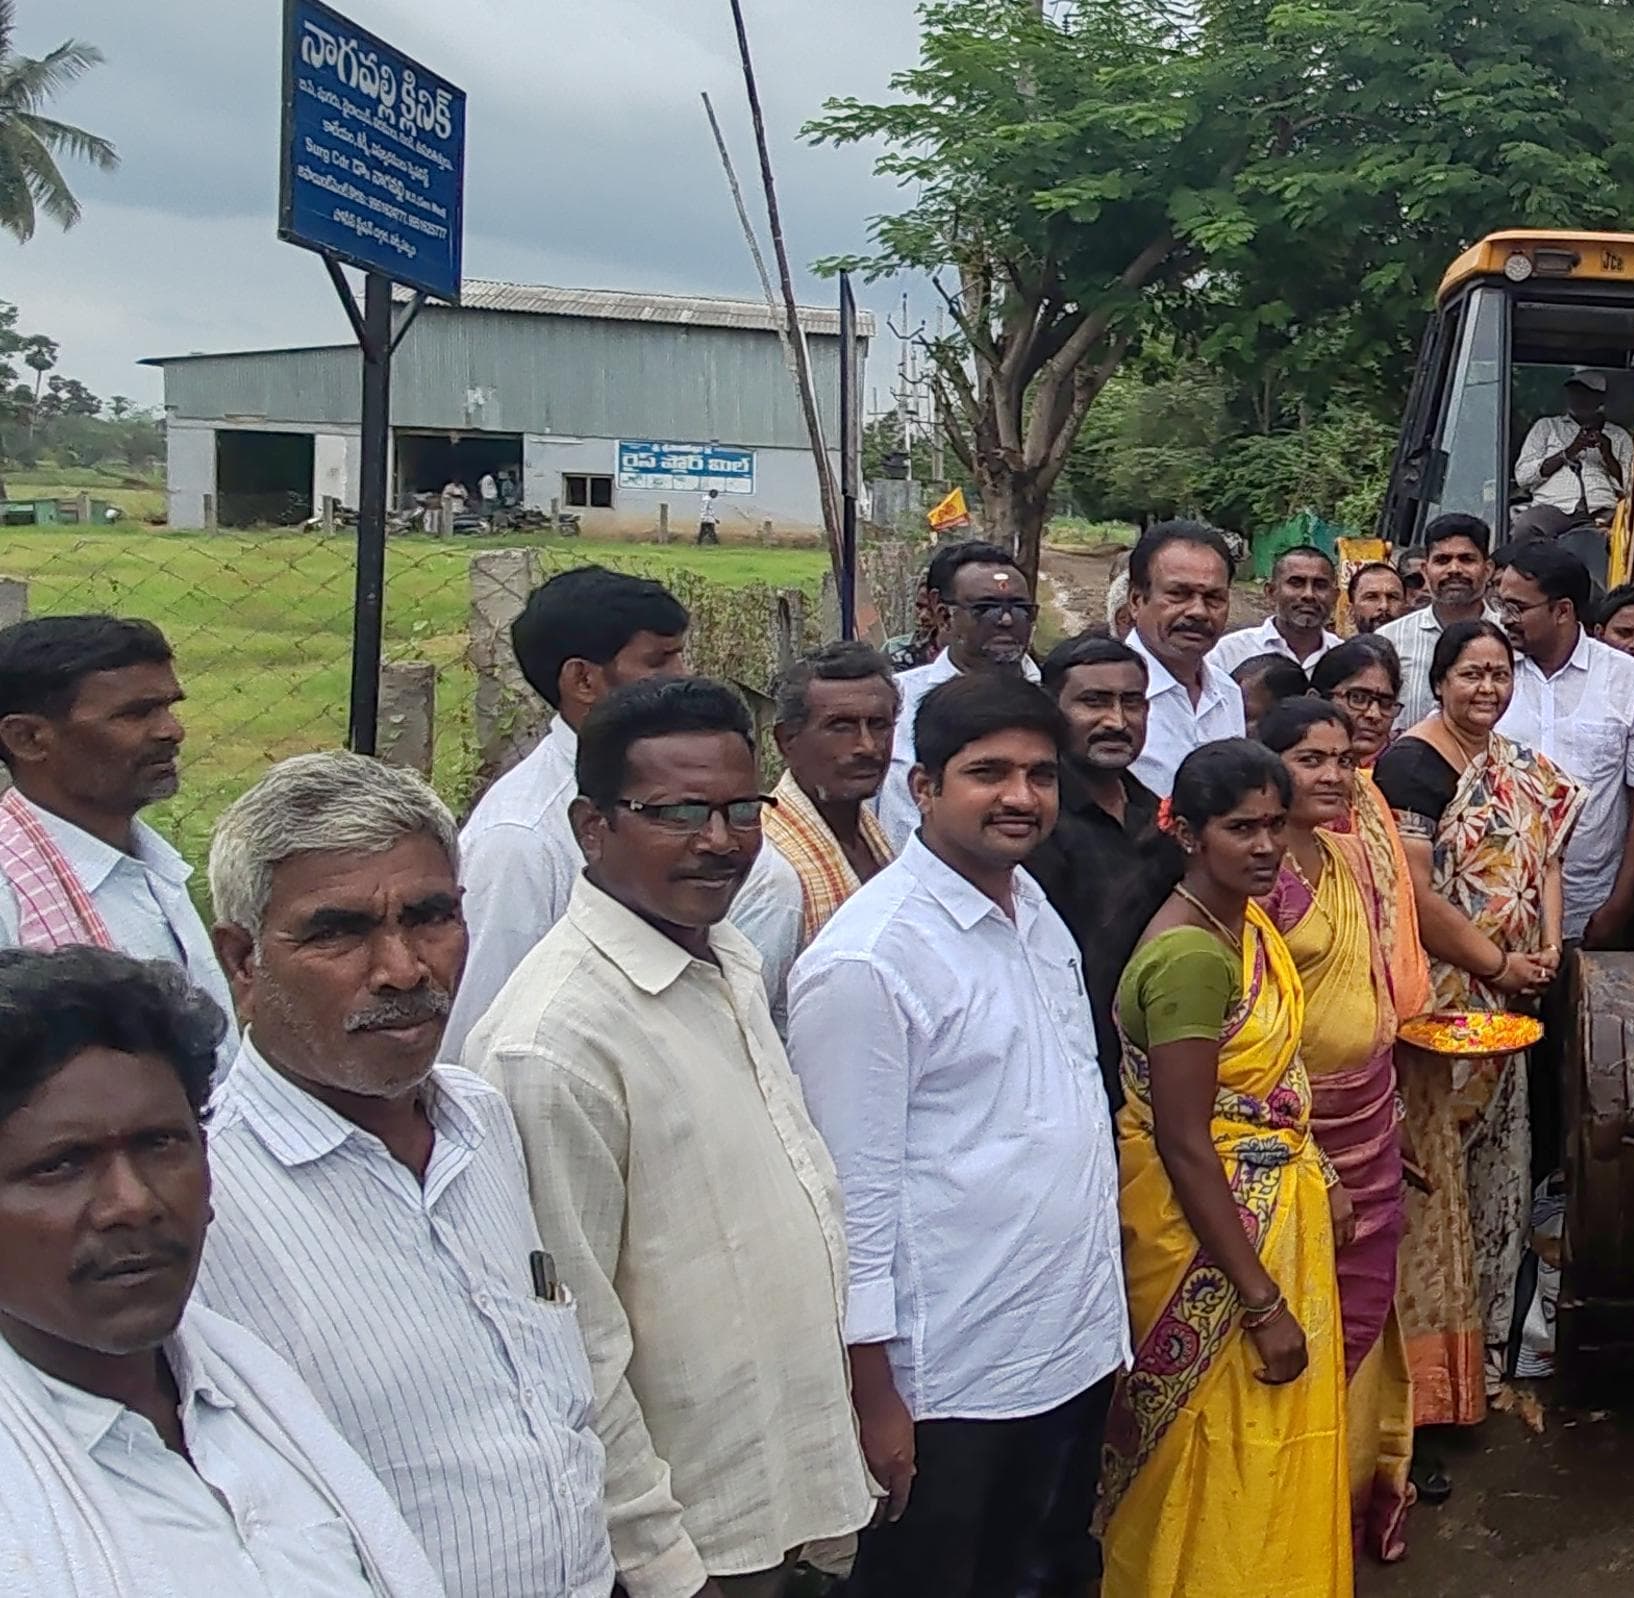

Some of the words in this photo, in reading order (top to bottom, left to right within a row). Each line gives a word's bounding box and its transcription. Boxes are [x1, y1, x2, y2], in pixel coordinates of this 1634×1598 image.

[302, 20, 396, 125] నాగవల్లి
[400, 69, 453, 139] క్లినిక్
[305, 136, 330, 164] Surg
[332, 150, 350, 170] Cdr
